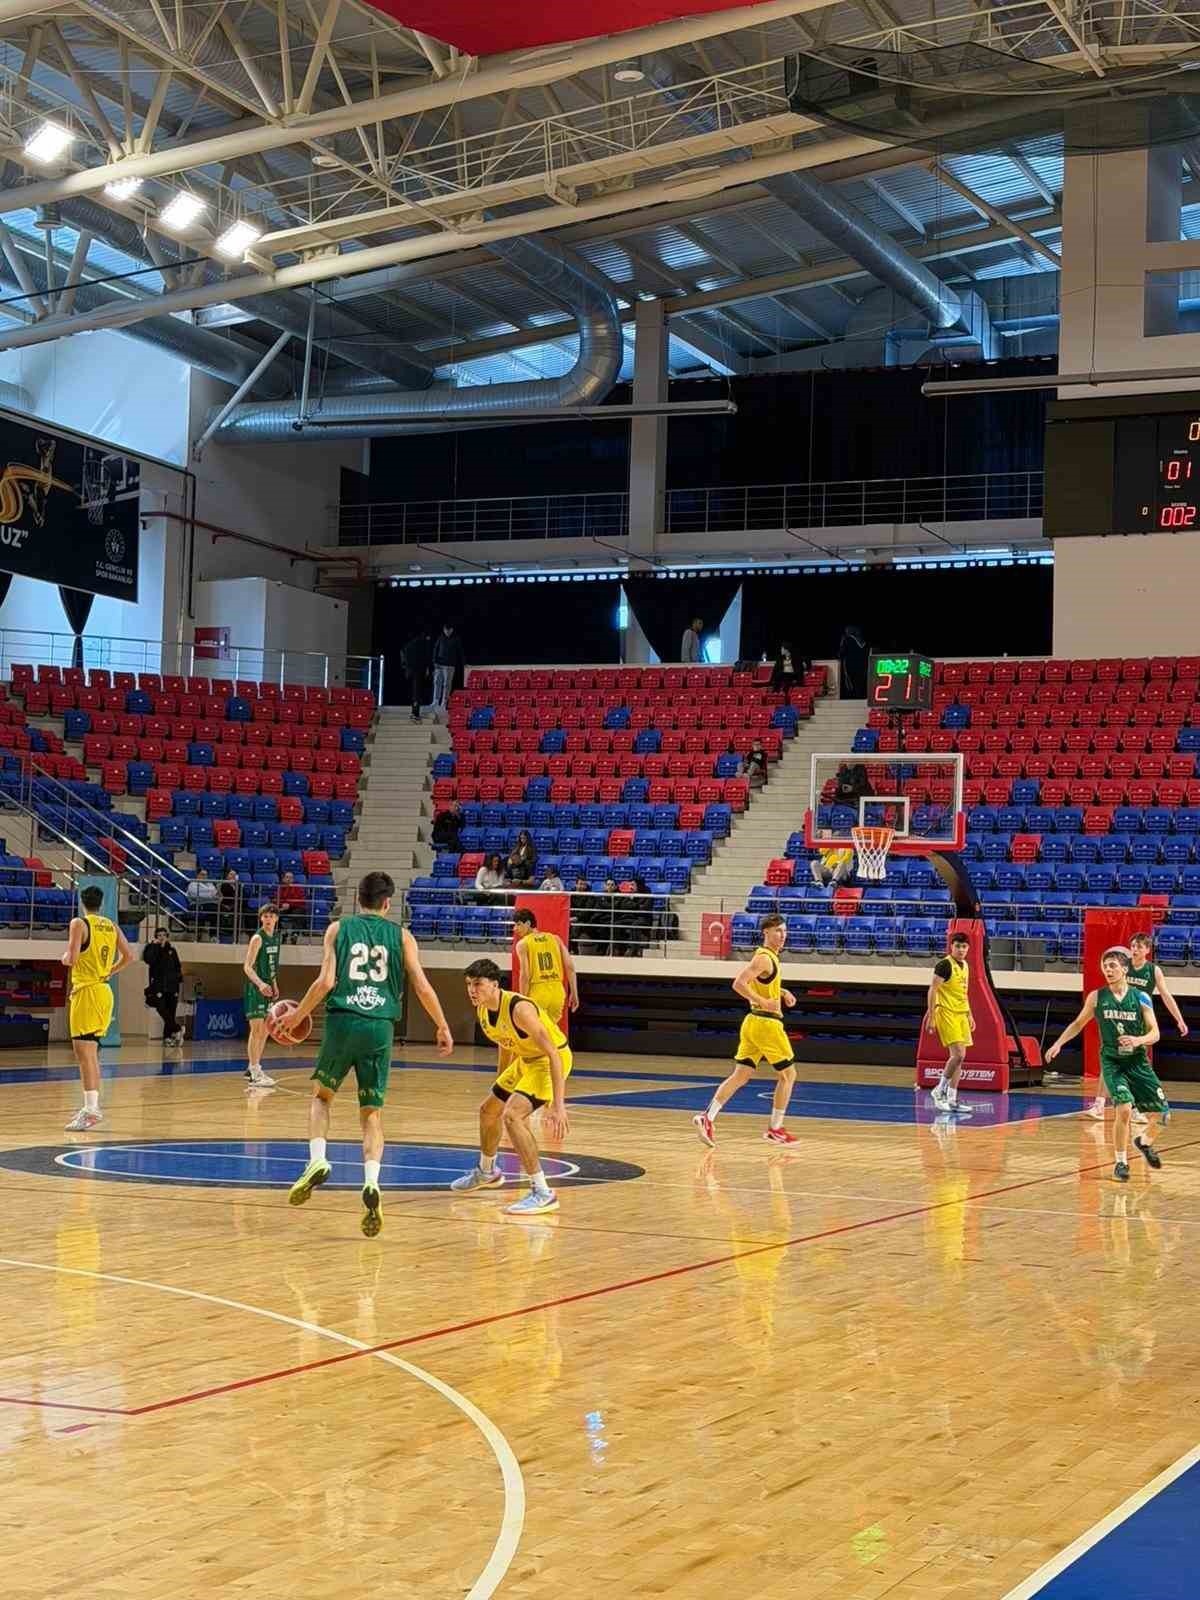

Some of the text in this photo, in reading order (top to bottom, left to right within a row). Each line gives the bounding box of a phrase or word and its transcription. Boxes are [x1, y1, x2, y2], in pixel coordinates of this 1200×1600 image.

[1167, 461, 1192, 480] 01
[1160, 507, 1196, 526] 002
[874, 674, 911, 701] 21
[349, 943, 388, 982] 23
